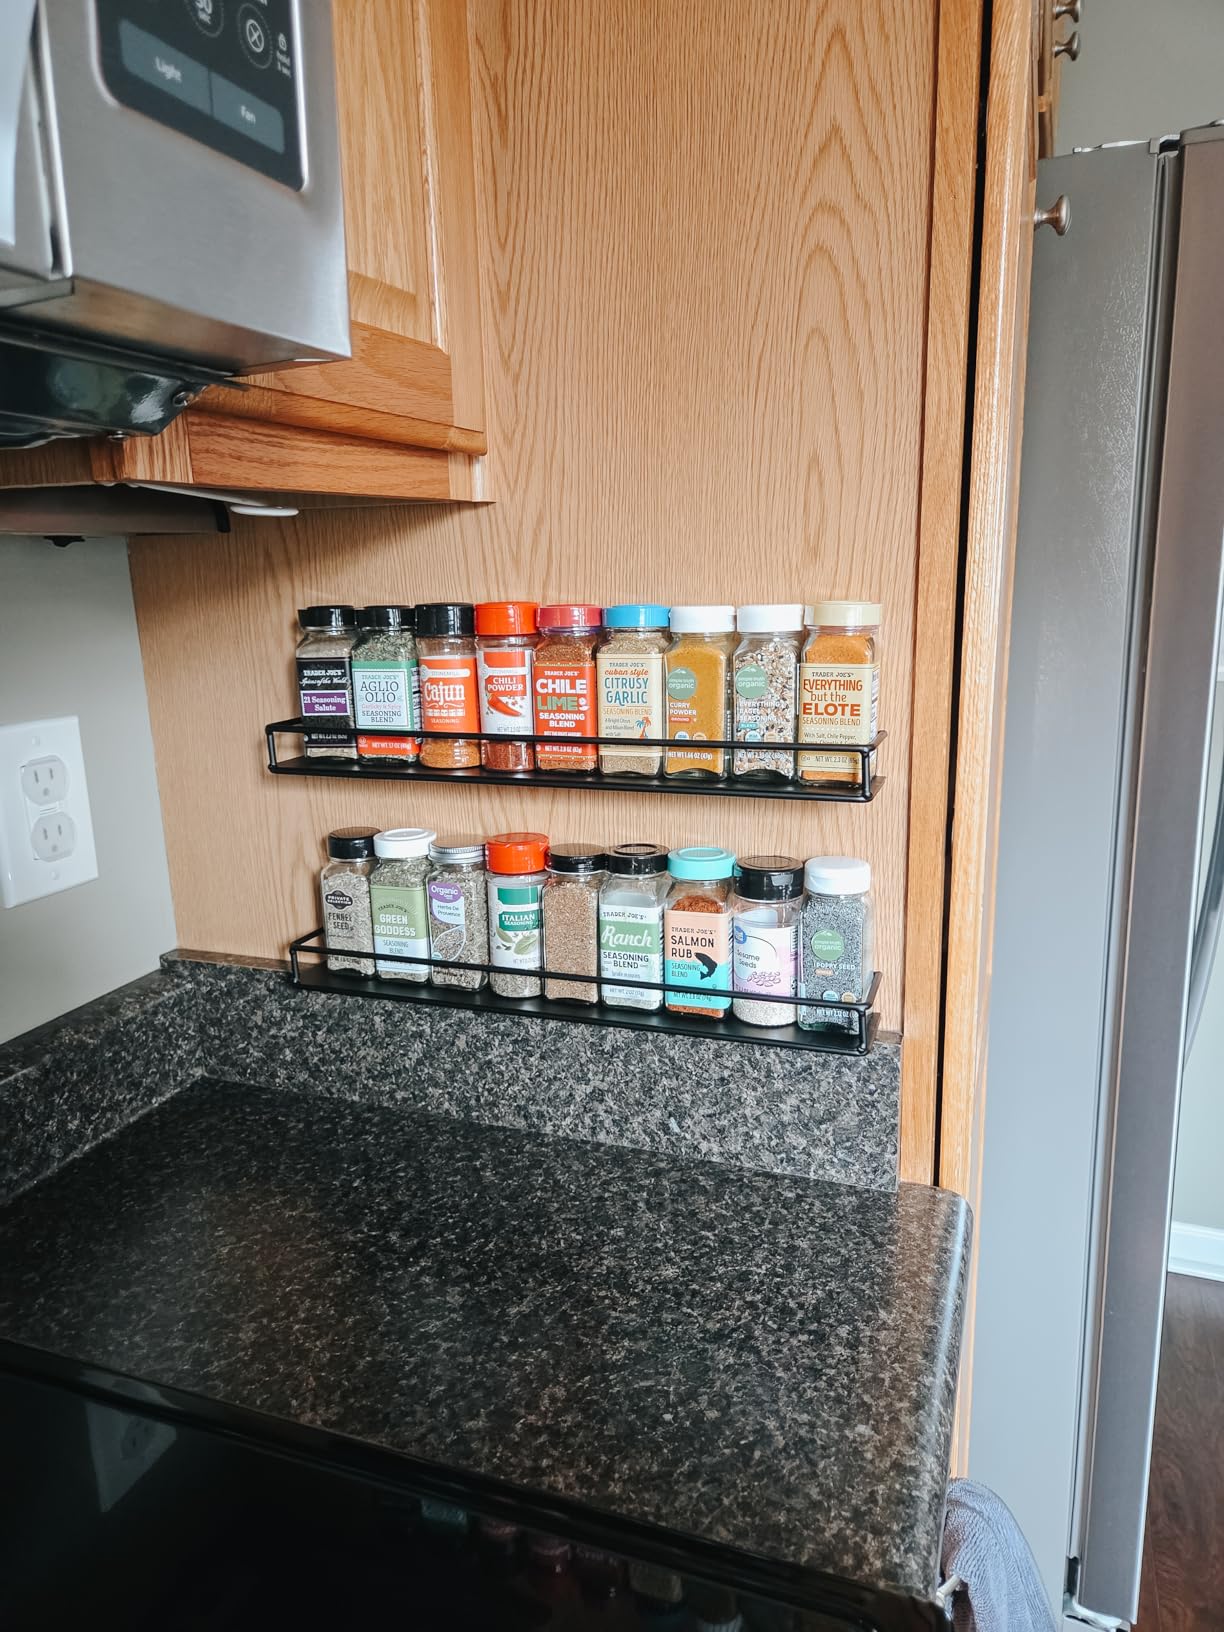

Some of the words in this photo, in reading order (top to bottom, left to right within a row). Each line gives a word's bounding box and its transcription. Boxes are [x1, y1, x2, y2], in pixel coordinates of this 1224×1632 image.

[240, 105, 256, 124] Fan
[604, 668, 628, 676] cuban
[630, 668, 649, 677] style
[360, 681, 399, 692] AGLIO
[487, 684, 524, 692] POWDER
[536, 678, 588, 694] CHILE
[604, 677, 649, 689] CITRUSY
[668, 682, 694, 690] organic
[738, 681, 766, 689] organic
[803, 679, 863, 693] EVERYTHING
[365, 692, 396, 703] OLIO
[425, 681, 465, 705] Cajun
[606, 690, 648, 706] GARLIC
[810, 691, 828, 701] but
[830, 691, 847, 702] the
[303, 695, 311, 703] 21
[311, 695, 346, 704] Seasoning
[536, 696, 578, 711] LIME
[802, 703, 861, 717] ELOTE
[539, 712, 585, 720] SEASONING
[549, 720, 576, 728] BLEND
[802, 717, 839, 725] SEASONING
[840, 718, 861, 726] BLEND
[431, 885, 458, 896] Organic
[328, 912, 353, 921] FENNEL
[379, 913, 408, 925] GREEN
[502, 912, 535, 921] ITALIAN
[627, 912, 644, 920] JOE'S
[333, 921, 350, 930] SEED
[671, 926, 695, 934] TRADER
[374, 925, 416, 937] GODDESS
[601, 925, 653, 947] Ranch
[383, 939, 408, 948] SEASONING
[671, 935, 715, 948] SALMON
[603, 951, 649, 962] SEASONING
[671, 948, 692, 959] RUB
[737, 949, 760, 961] Sesame
[613, 960, 639, 969] BLEND
[671, 962, 701, 971] SEASONING
[739, 959, 757, 969] Seeds
[816, 962, 837, 970] POPPY
[671, 970, 688, 978] BLEND
